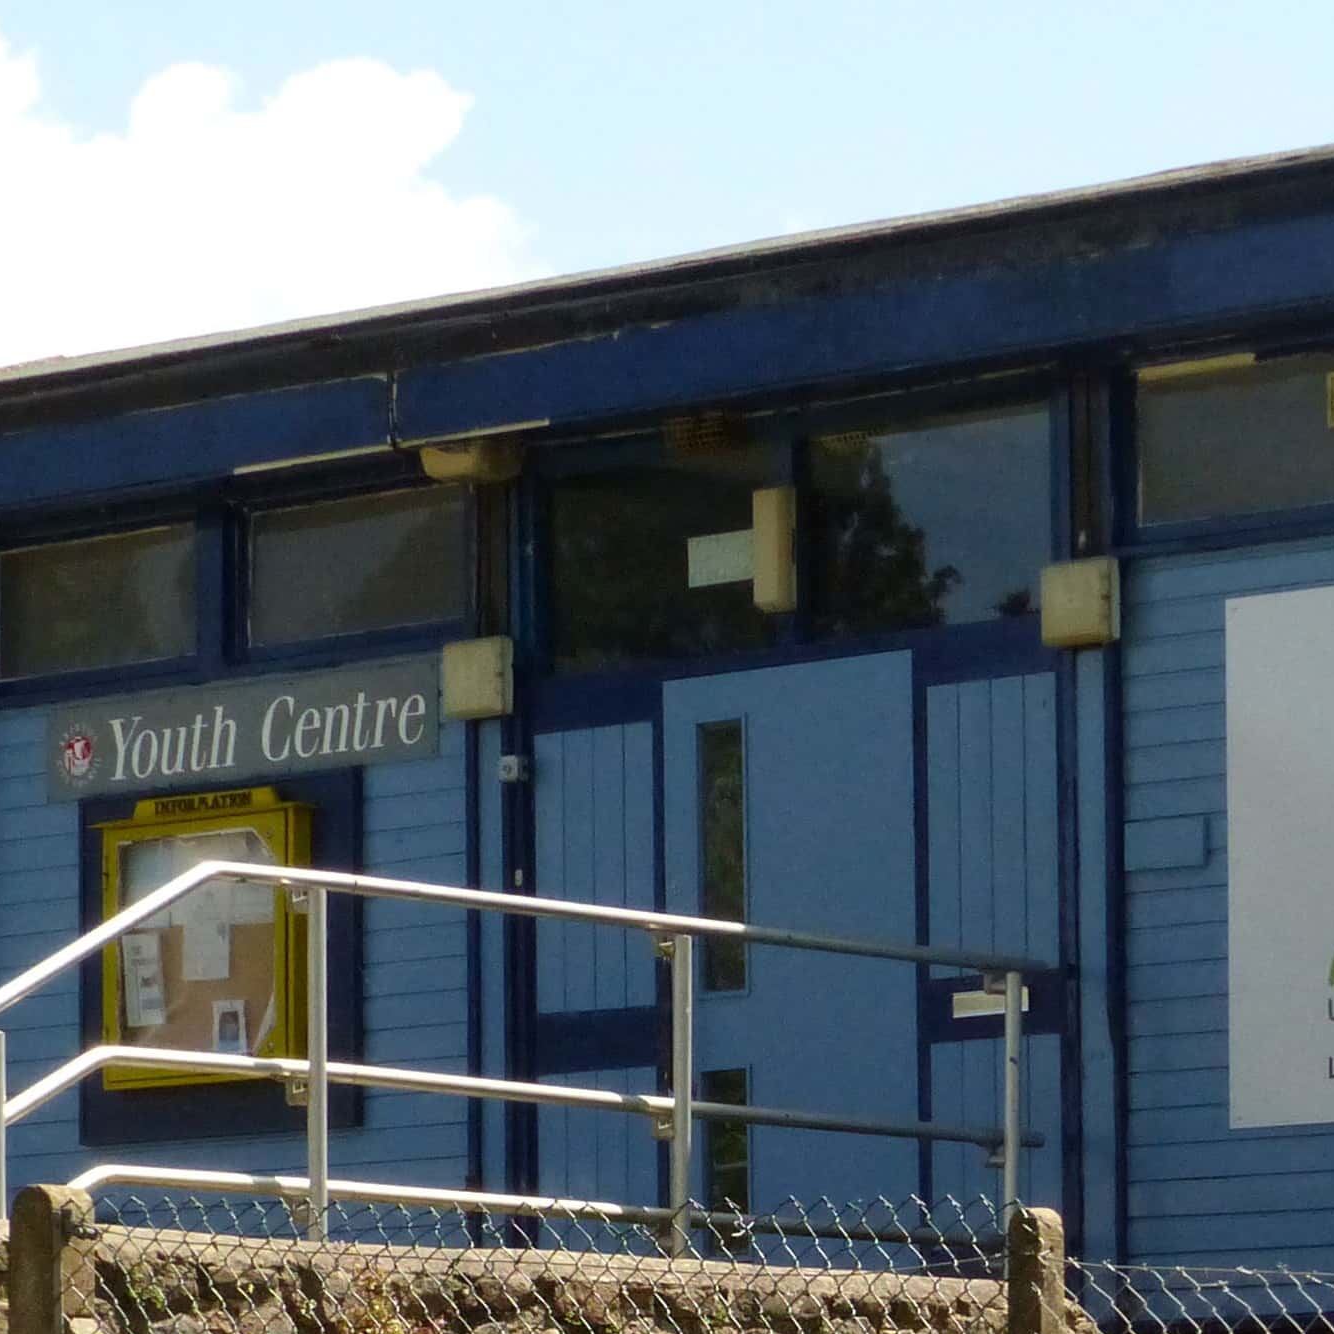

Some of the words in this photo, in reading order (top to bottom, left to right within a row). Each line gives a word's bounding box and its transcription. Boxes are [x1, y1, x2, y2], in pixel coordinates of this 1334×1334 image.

[109, 706, 237, 781] Youth
[261, 691, 426, 762] Centre
[154, 791, 252, 816] INFORMATION
